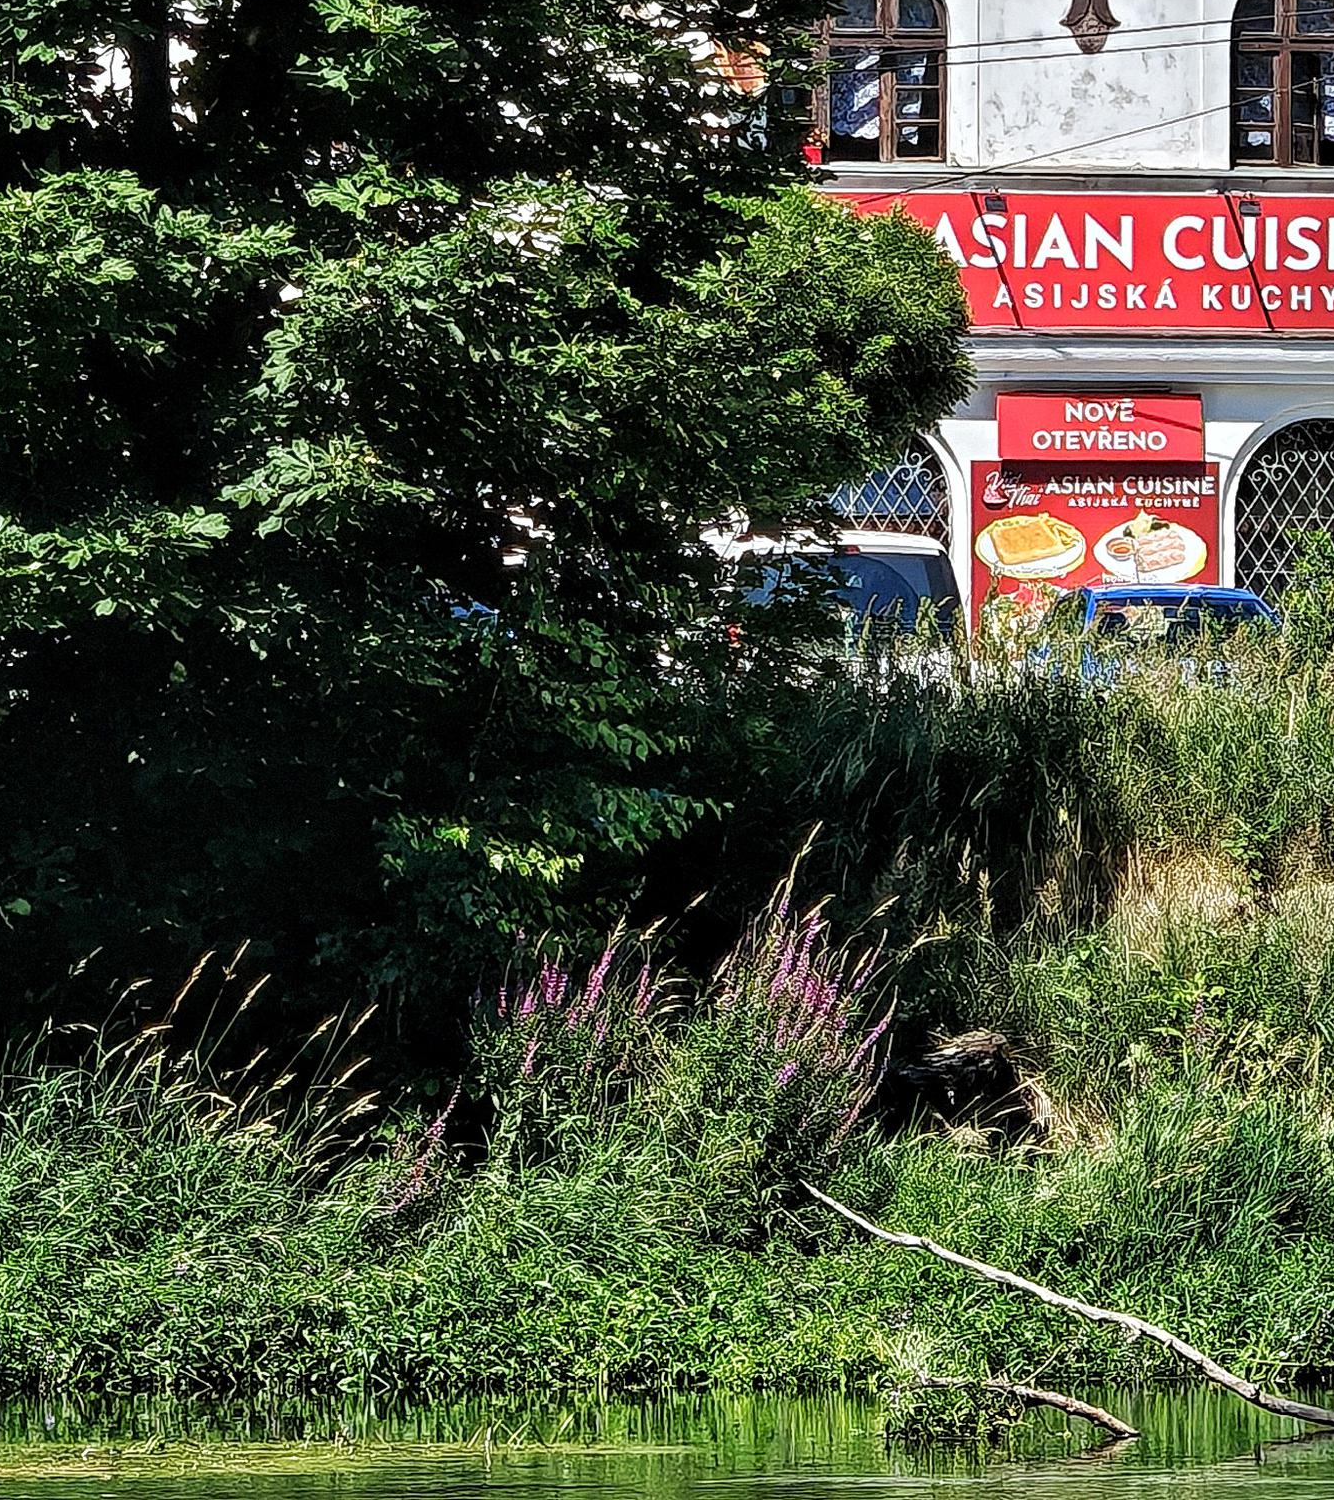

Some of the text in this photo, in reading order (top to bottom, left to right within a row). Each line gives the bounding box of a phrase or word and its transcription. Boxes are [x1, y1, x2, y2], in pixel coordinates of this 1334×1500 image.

[933, 211, 1133, 271] ASIAN
[992, 277, 1177, 309] ASIJSKÁ
[1032, 426, 1167, 451] OTEVŘENO
[1045, 475, 1215, 495] ASIAN CUISINE
